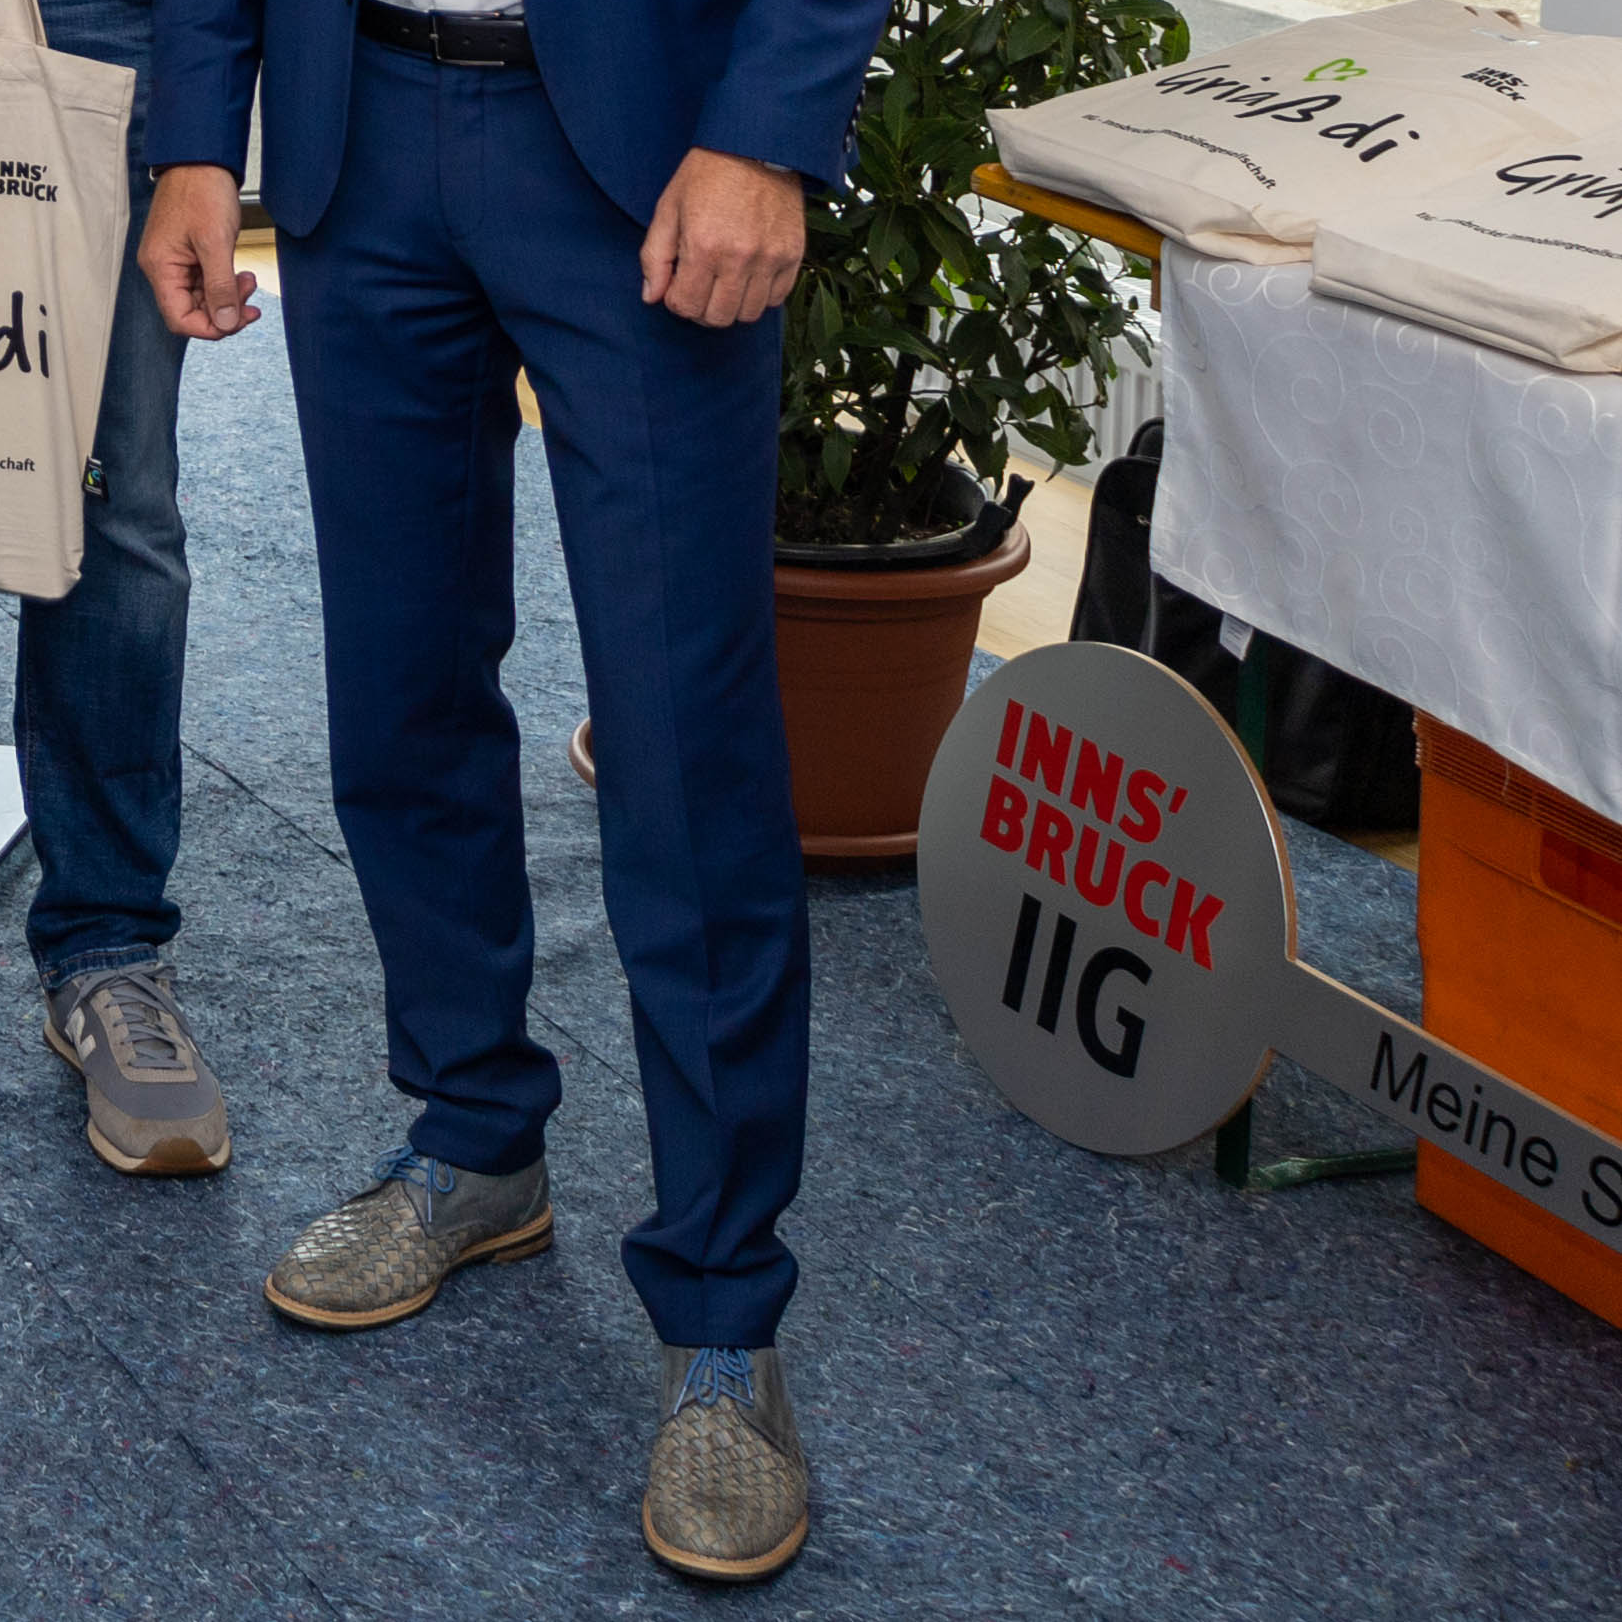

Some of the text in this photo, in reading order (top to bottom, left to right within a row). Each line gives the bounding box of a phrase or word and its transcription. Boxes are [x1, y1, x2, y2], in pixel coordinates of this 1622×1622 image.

[995, 697, 1188, 844] INNS'
[979, 773, 1225, 972] BRUCK
[1002, 892, 1153, 1079] IIG
[1370, 1031, 1557, 1188] Meine
